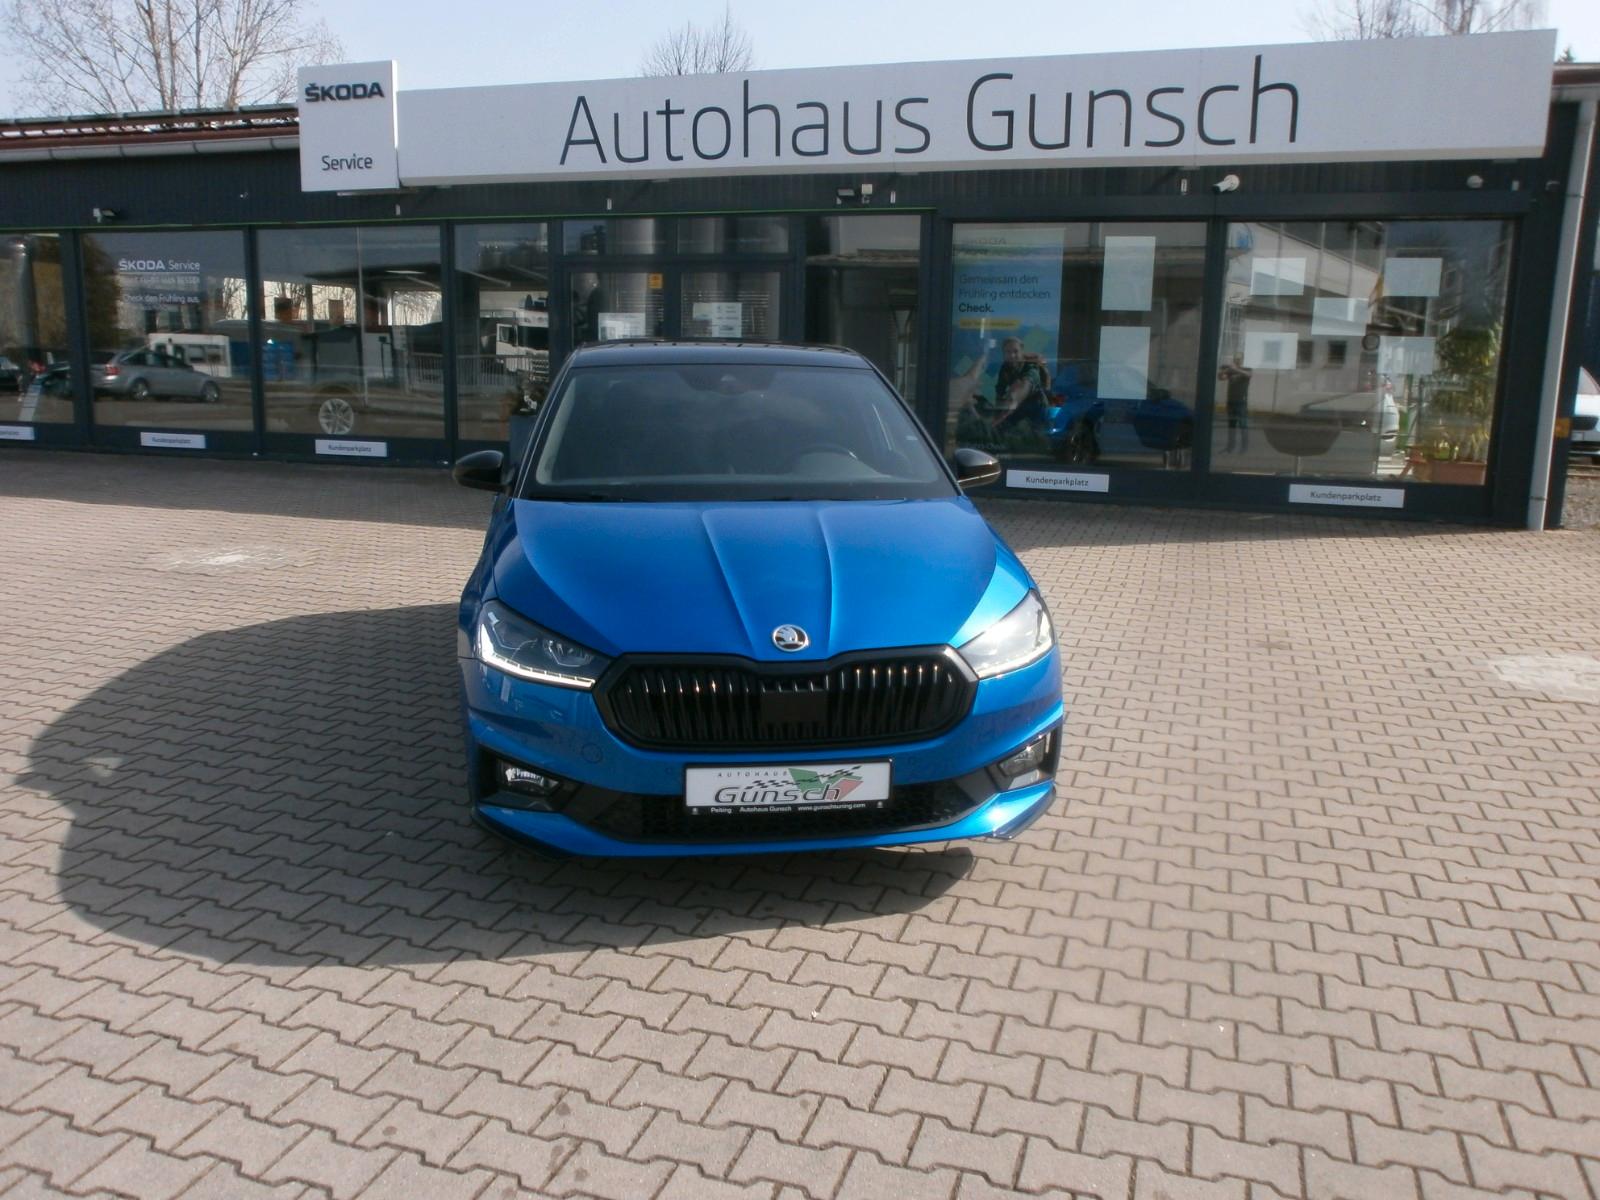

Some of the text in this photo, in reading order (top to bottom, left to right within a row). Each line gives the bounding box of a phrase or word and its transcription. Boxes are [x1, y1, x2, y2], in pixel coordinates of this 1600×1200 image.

[304, 82, 385, 102] ŠKODA
[559, 55, 1301, 165] Autohaus Gunsch
[321, 153, 373, 171] Service
[119, 258, 200, 271] ŠKODA Service
[960, 273, 1039, 285] Gemeinsam den
[1000, 288, 1050, 299] entdecken
[958, 302, 994, 313] Check.
[1025, 475, 1089, 487] Kundenparkplatz
[1310, 490, 1382, 502] Kundenparkplatz
